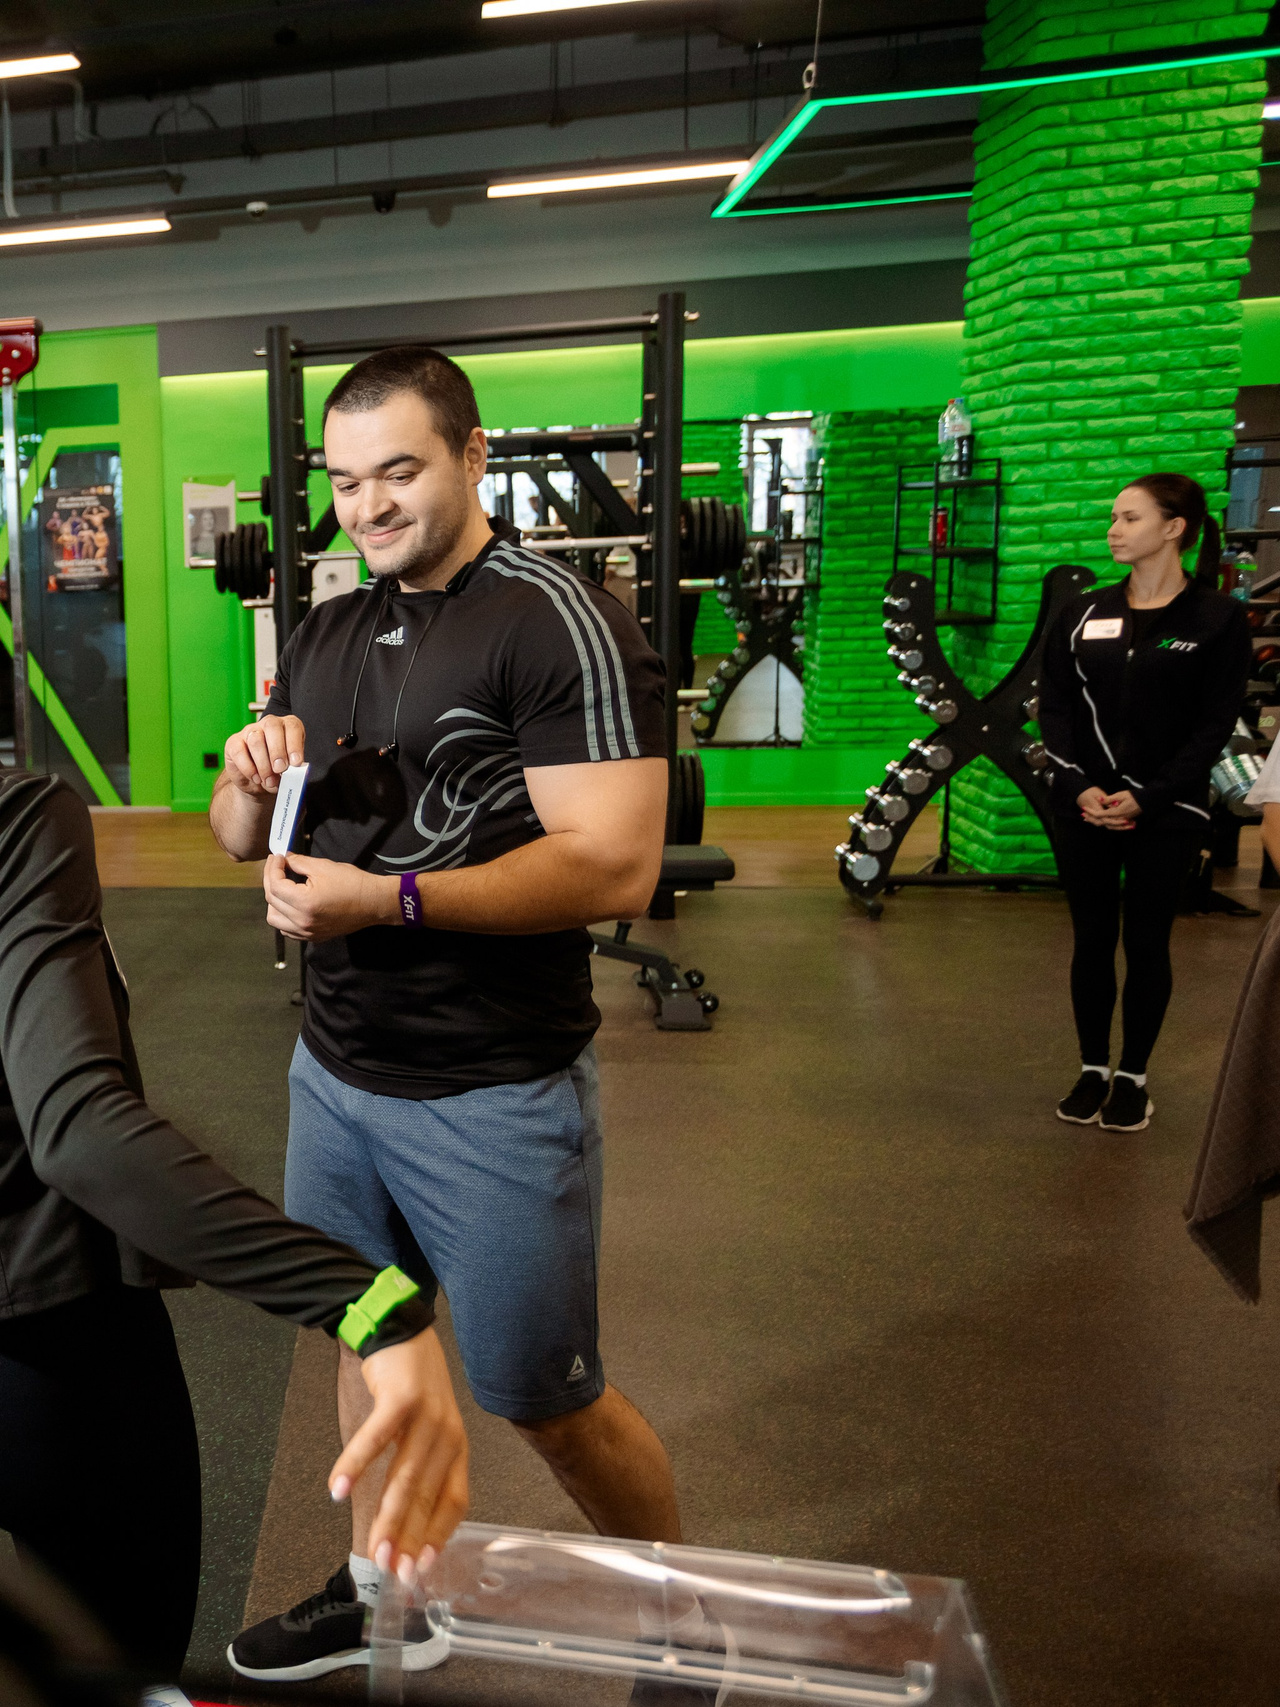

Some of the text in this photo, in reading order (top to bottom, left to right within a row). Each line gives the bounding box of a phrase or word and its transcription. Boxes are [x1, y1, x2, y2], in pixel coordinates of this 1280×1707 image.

[375, 636, 405, 646] adidas
[1157, 637, 1198, 652] XFIT
[285, 788, 293, 808] напиток
[403, 894, 416, 921] XFIT
